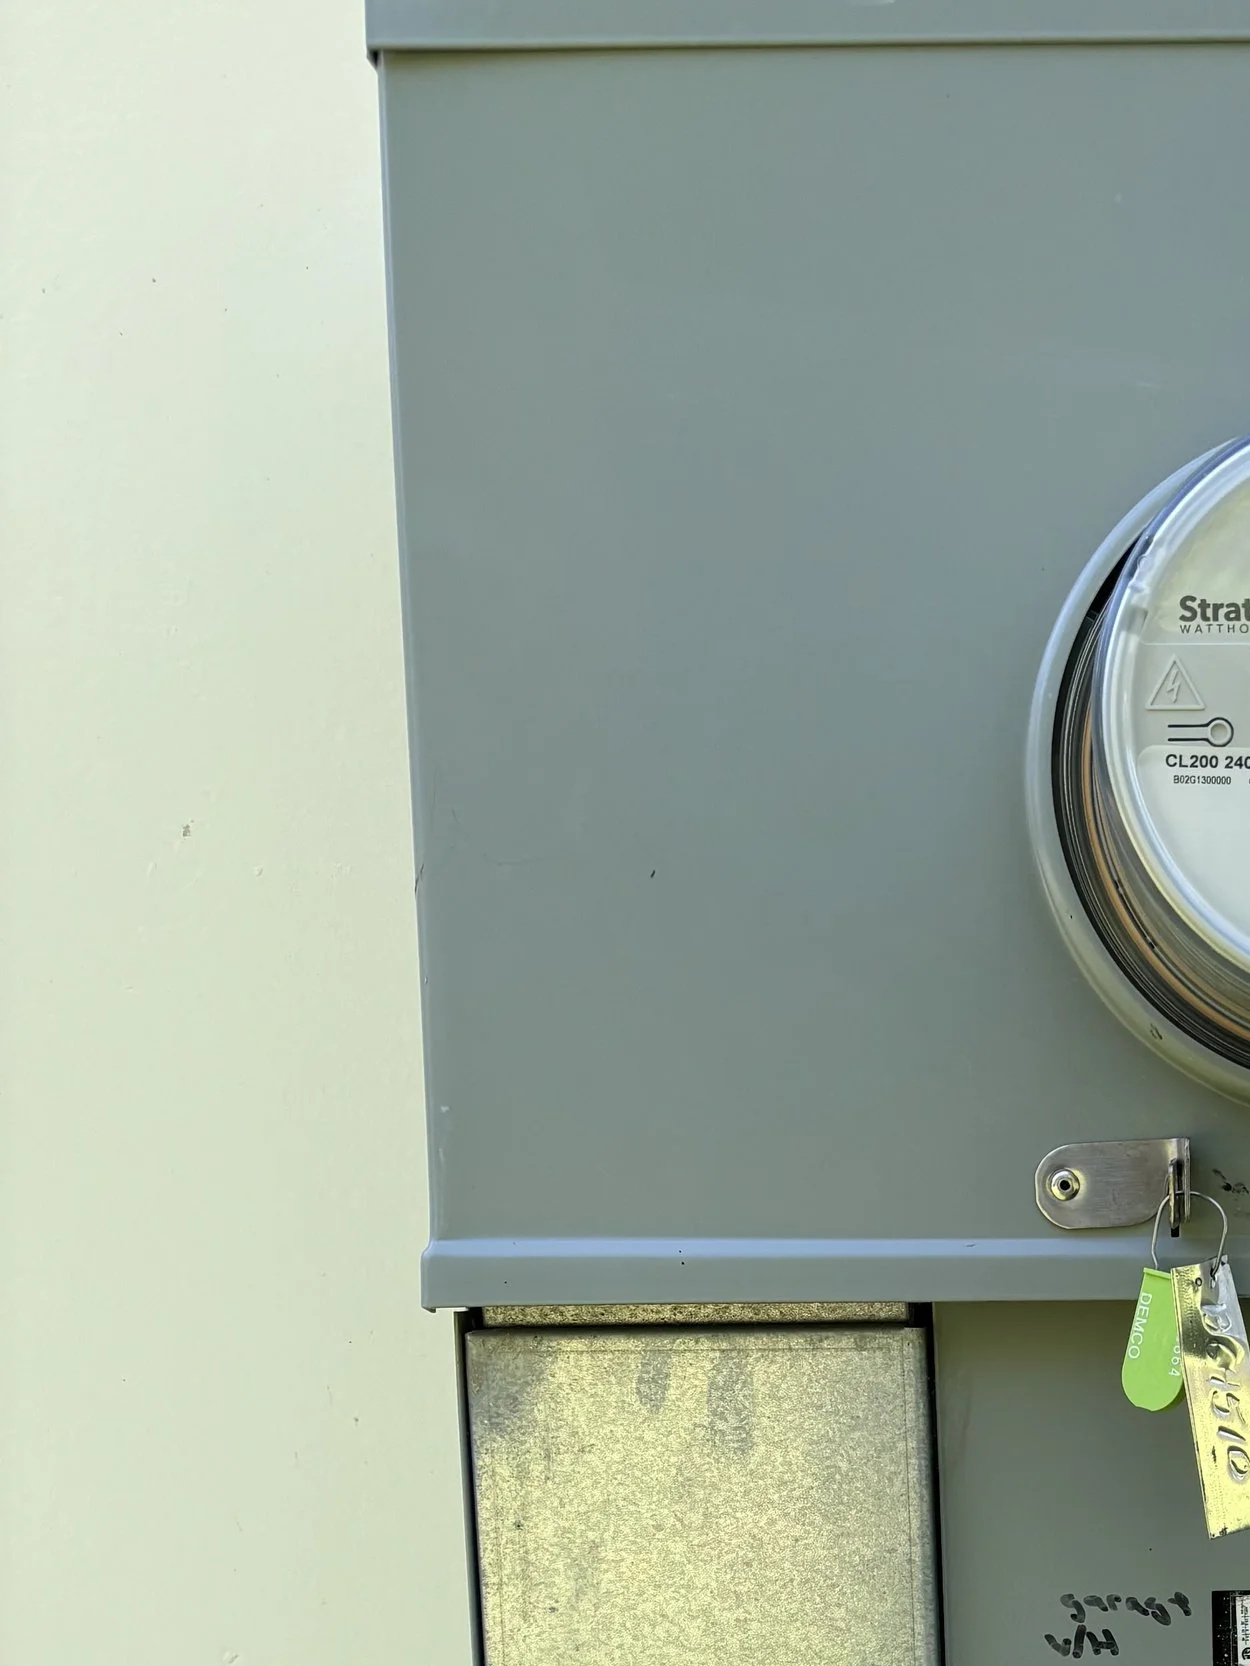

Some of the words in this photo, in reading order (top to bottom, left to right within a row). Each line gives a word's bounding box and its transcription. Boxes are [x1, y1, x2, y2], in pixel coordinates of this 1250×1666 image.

[1165, 753, 1219, 769] CL200
[1173, 774, 1232, 785] B02G1300000
[1127, 1292, 1153, 1359] DEMCO
